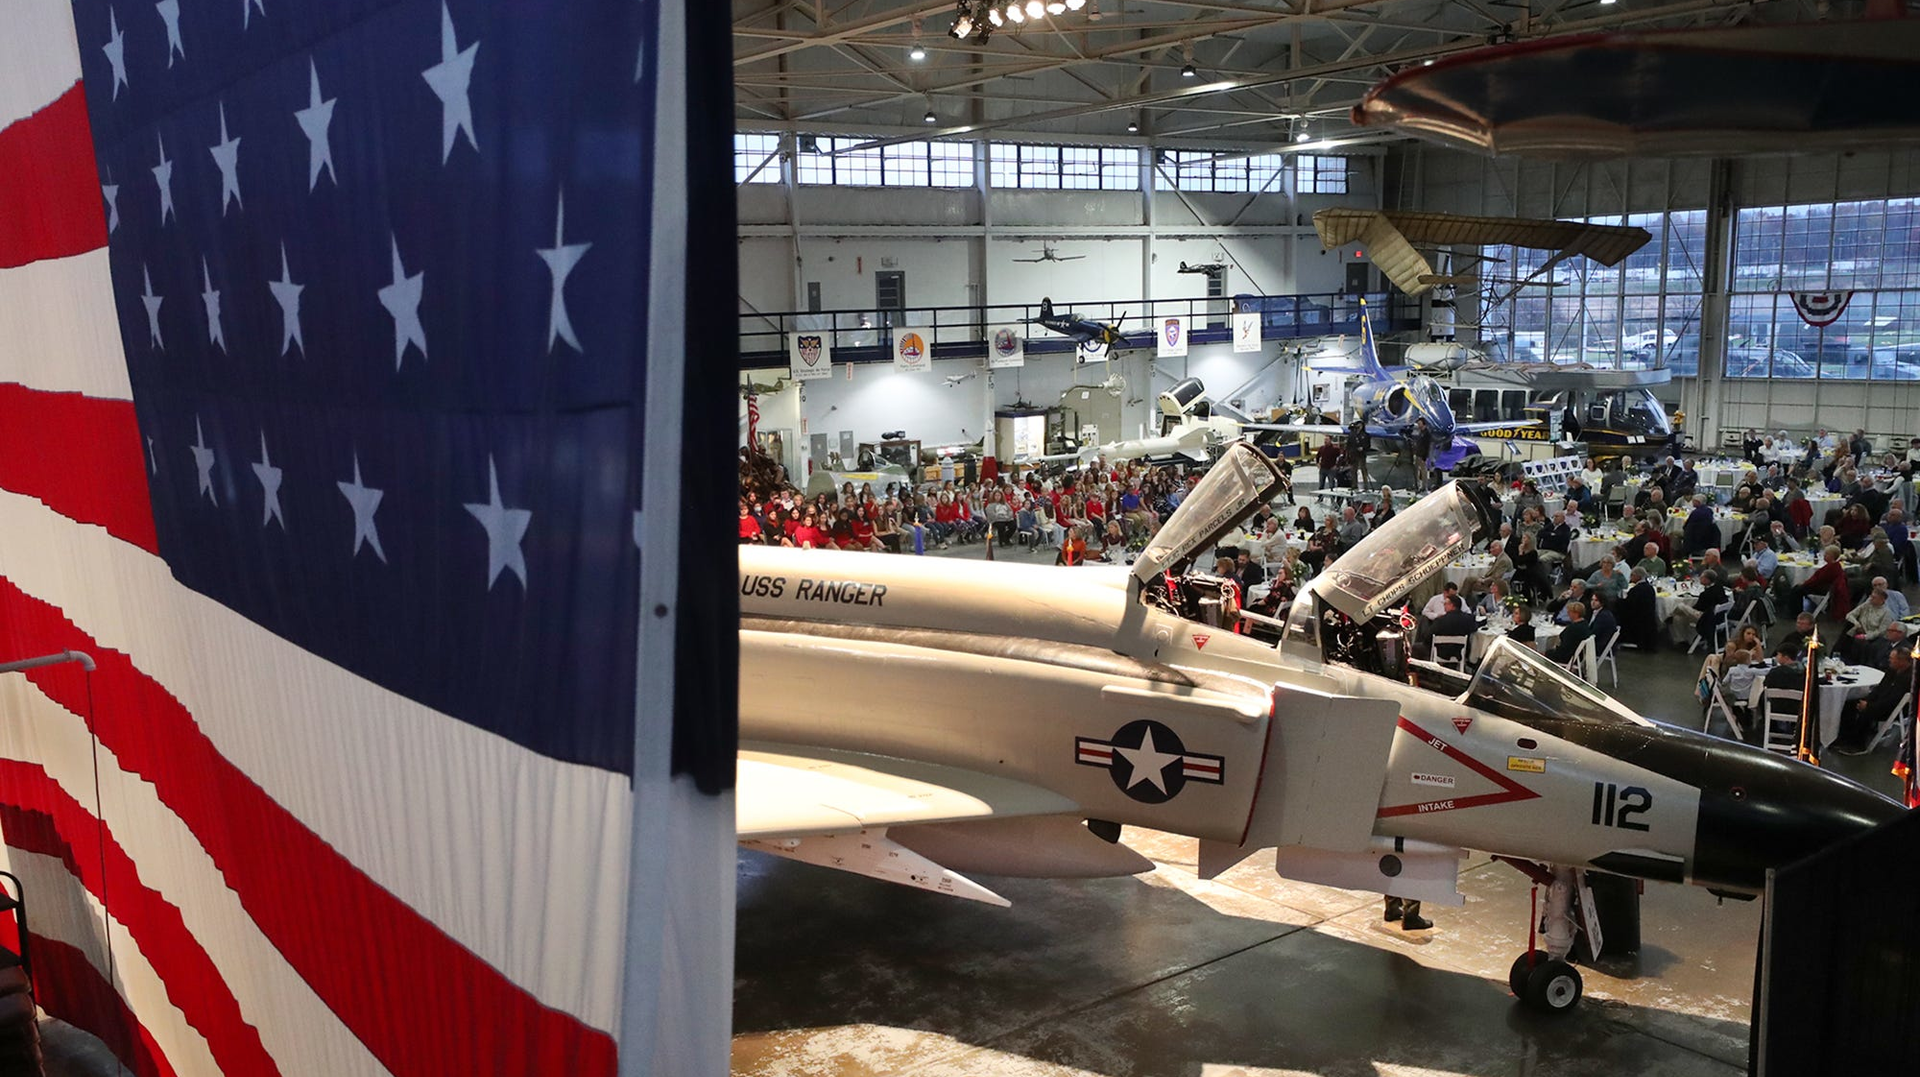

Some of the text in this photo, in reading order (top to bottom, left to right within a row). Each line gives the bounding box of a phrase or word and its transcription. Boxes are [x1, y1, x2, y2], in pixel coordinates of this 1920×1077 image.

[1199, 509, 1233, 538] PARCELS
[741, 575, 887, 606] USS RANGER
[1362, 542, 1465, 617] LT CHOPS SCHOEPPNER
[1428, 737, 1448, 751] JET
[1420, 774, 1454, 785] DANGER
[1418, 800, 1455, 813] INTAKE
[1592, 782, 1653, 832] 112
